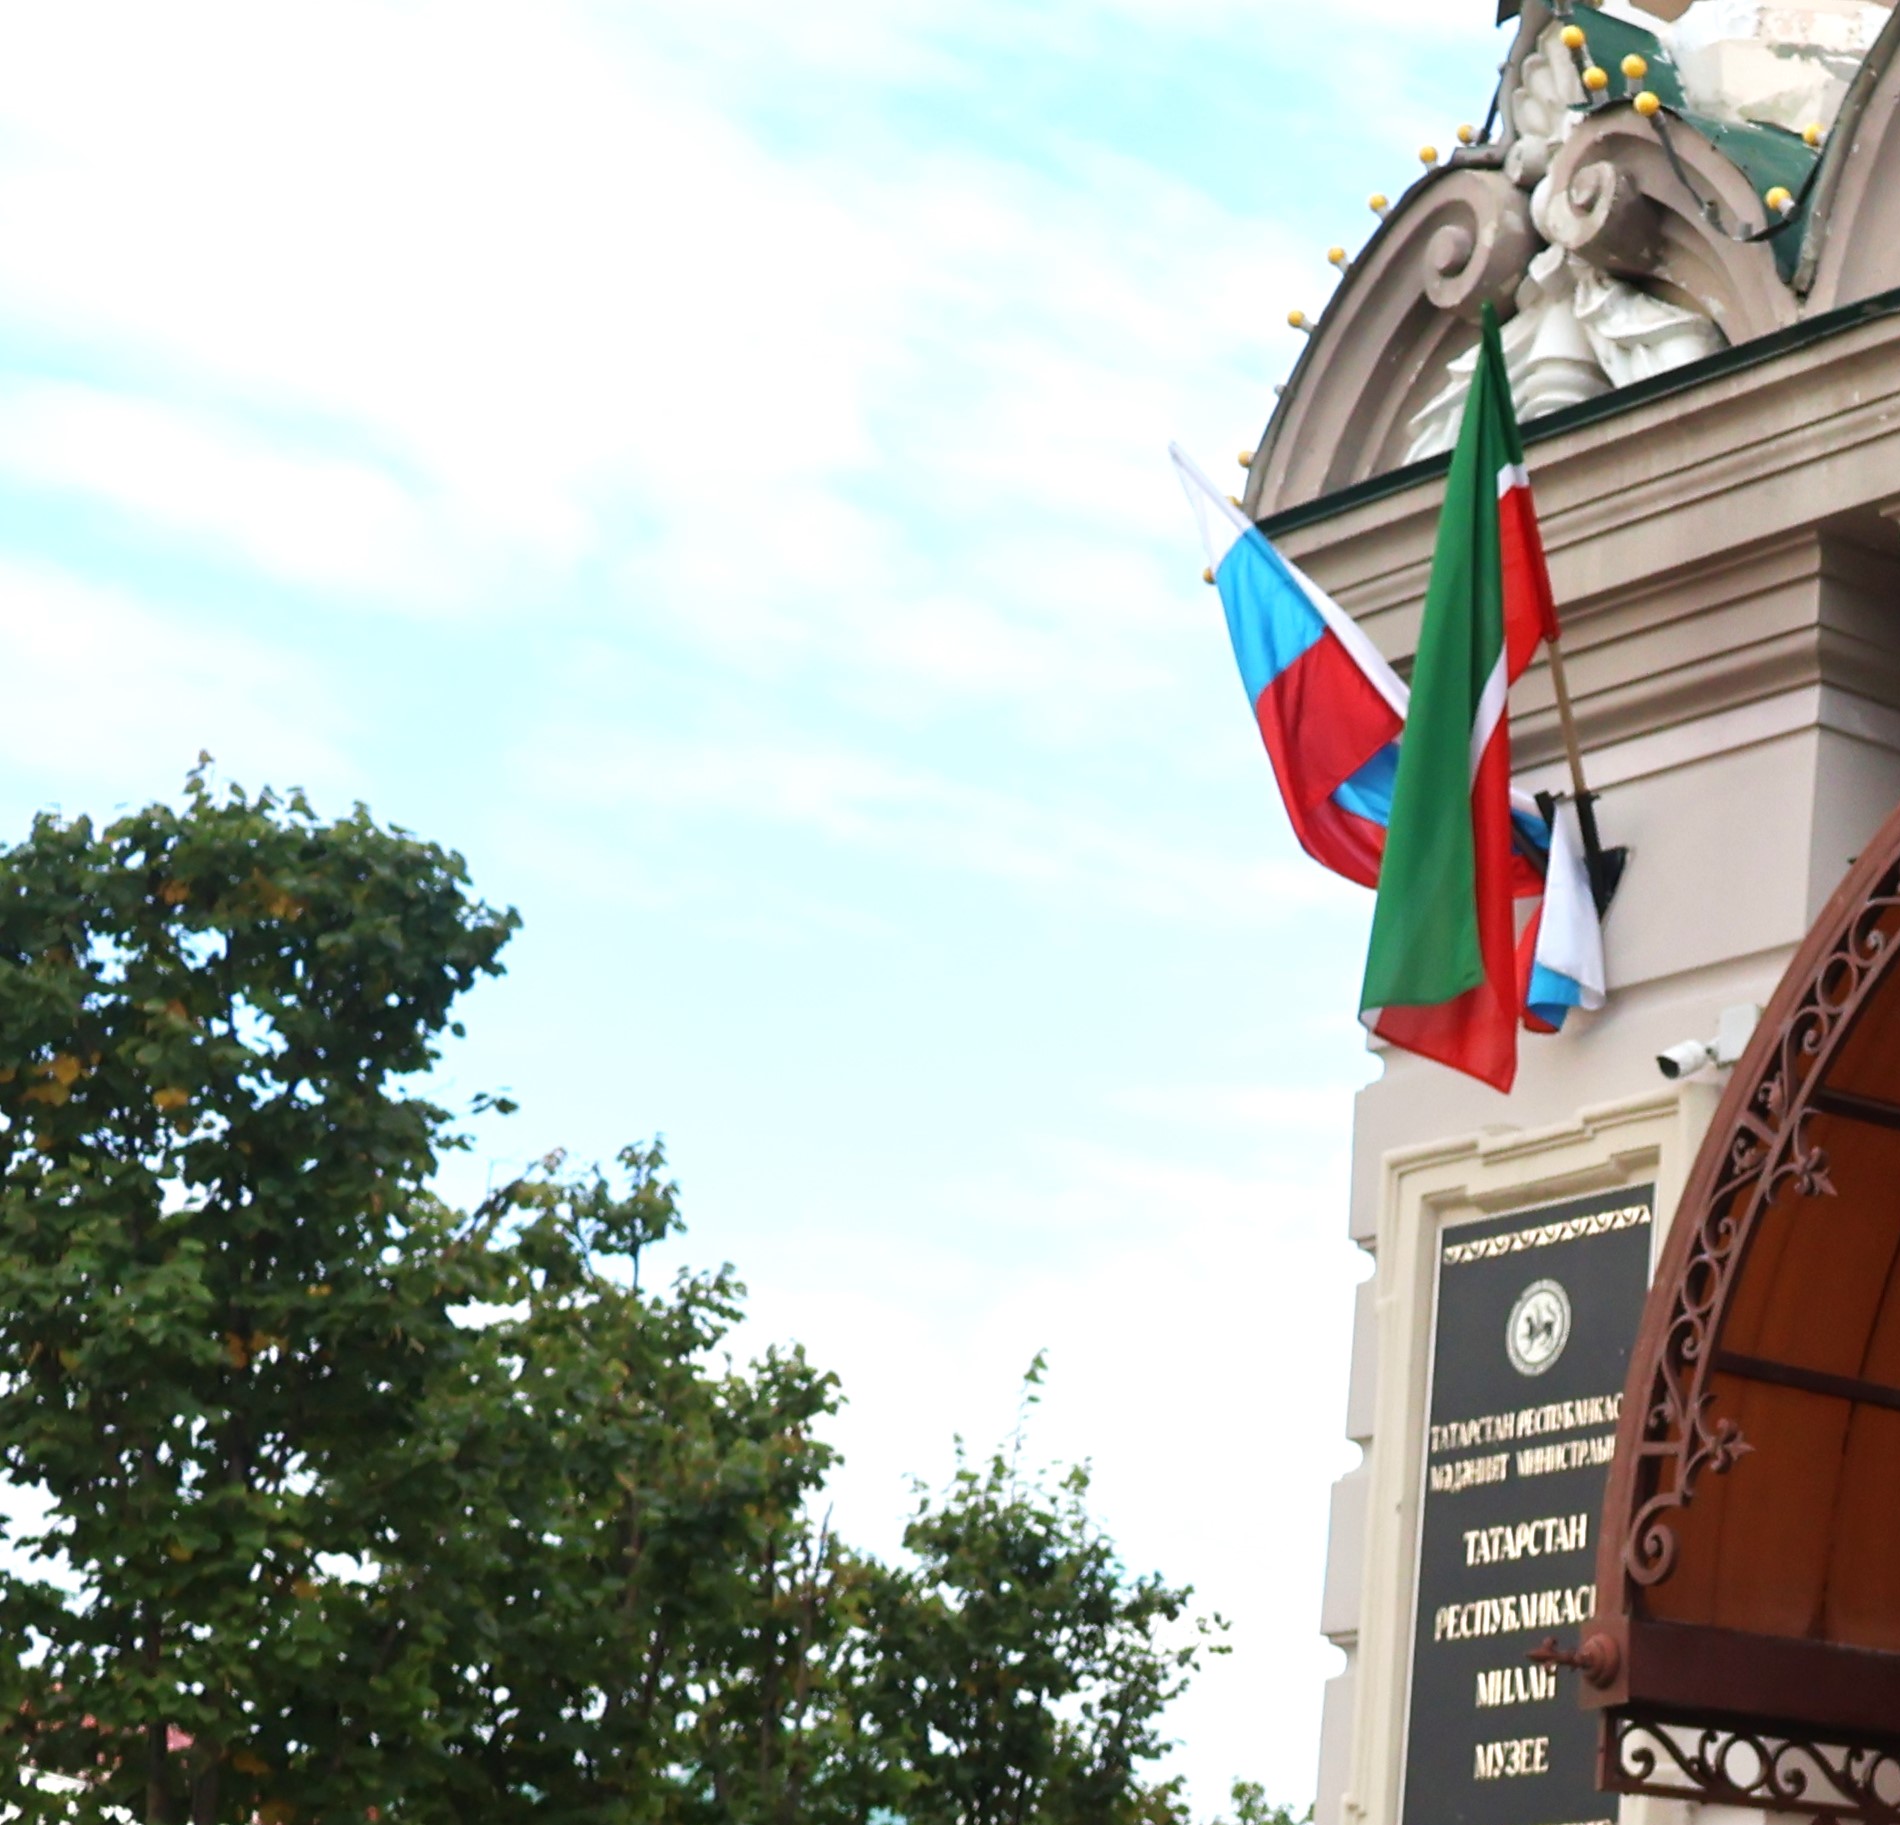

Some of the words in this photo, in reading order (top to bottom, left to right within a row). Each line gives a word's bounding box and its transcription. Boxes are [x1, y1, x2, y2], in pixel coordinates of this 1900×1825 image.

[1430, 1412, 1516, 1453] ТАТАРСТАН
[1515, 1391, 1624, 1439] РЕСПУБЛИКАС
[1462, 1512, 1588, 1568] ТАТАРСТАН
[1475, 1664, 1557, 1709] МИЛЛИ
[1473, 1736, 1550, 1781] МУЗЕЕ
